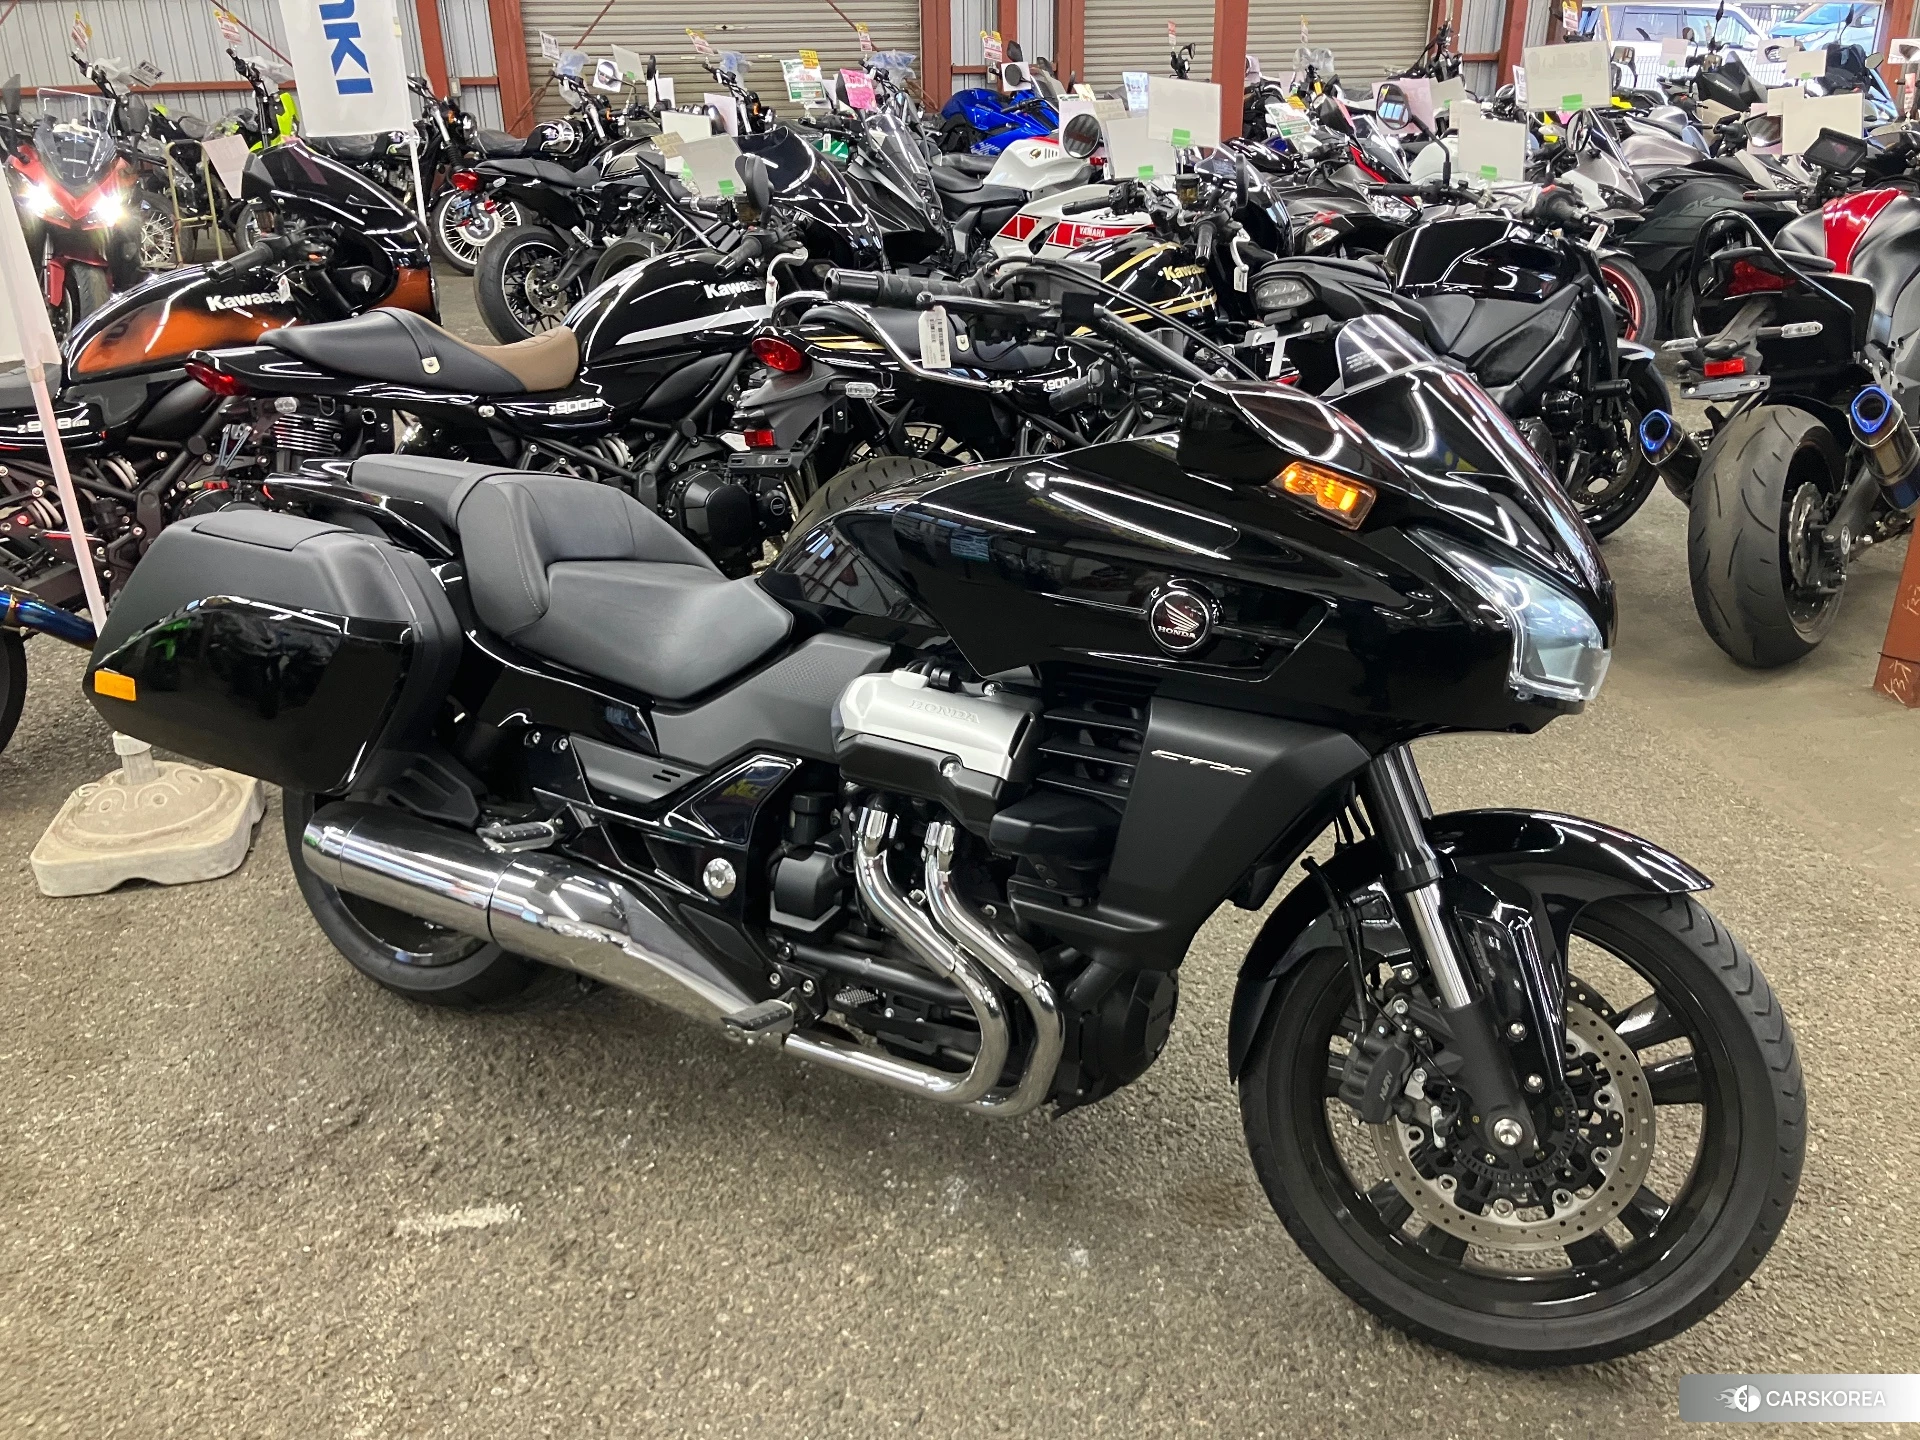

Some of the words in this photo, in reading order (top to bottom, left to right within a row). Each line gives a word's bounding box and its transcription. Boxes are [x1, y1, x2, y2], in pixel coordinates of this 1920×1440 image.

[1079, 226, 1106, 238] YAMAHA
[703, 278, 766, 299] Kawasa
[205, 291, 281, 312] Kawasa
[1157, 625, 1197, 640] HONDA
[908, 699, 980, 724] HONDA
[1150, 749, 1252, 776] CTX
